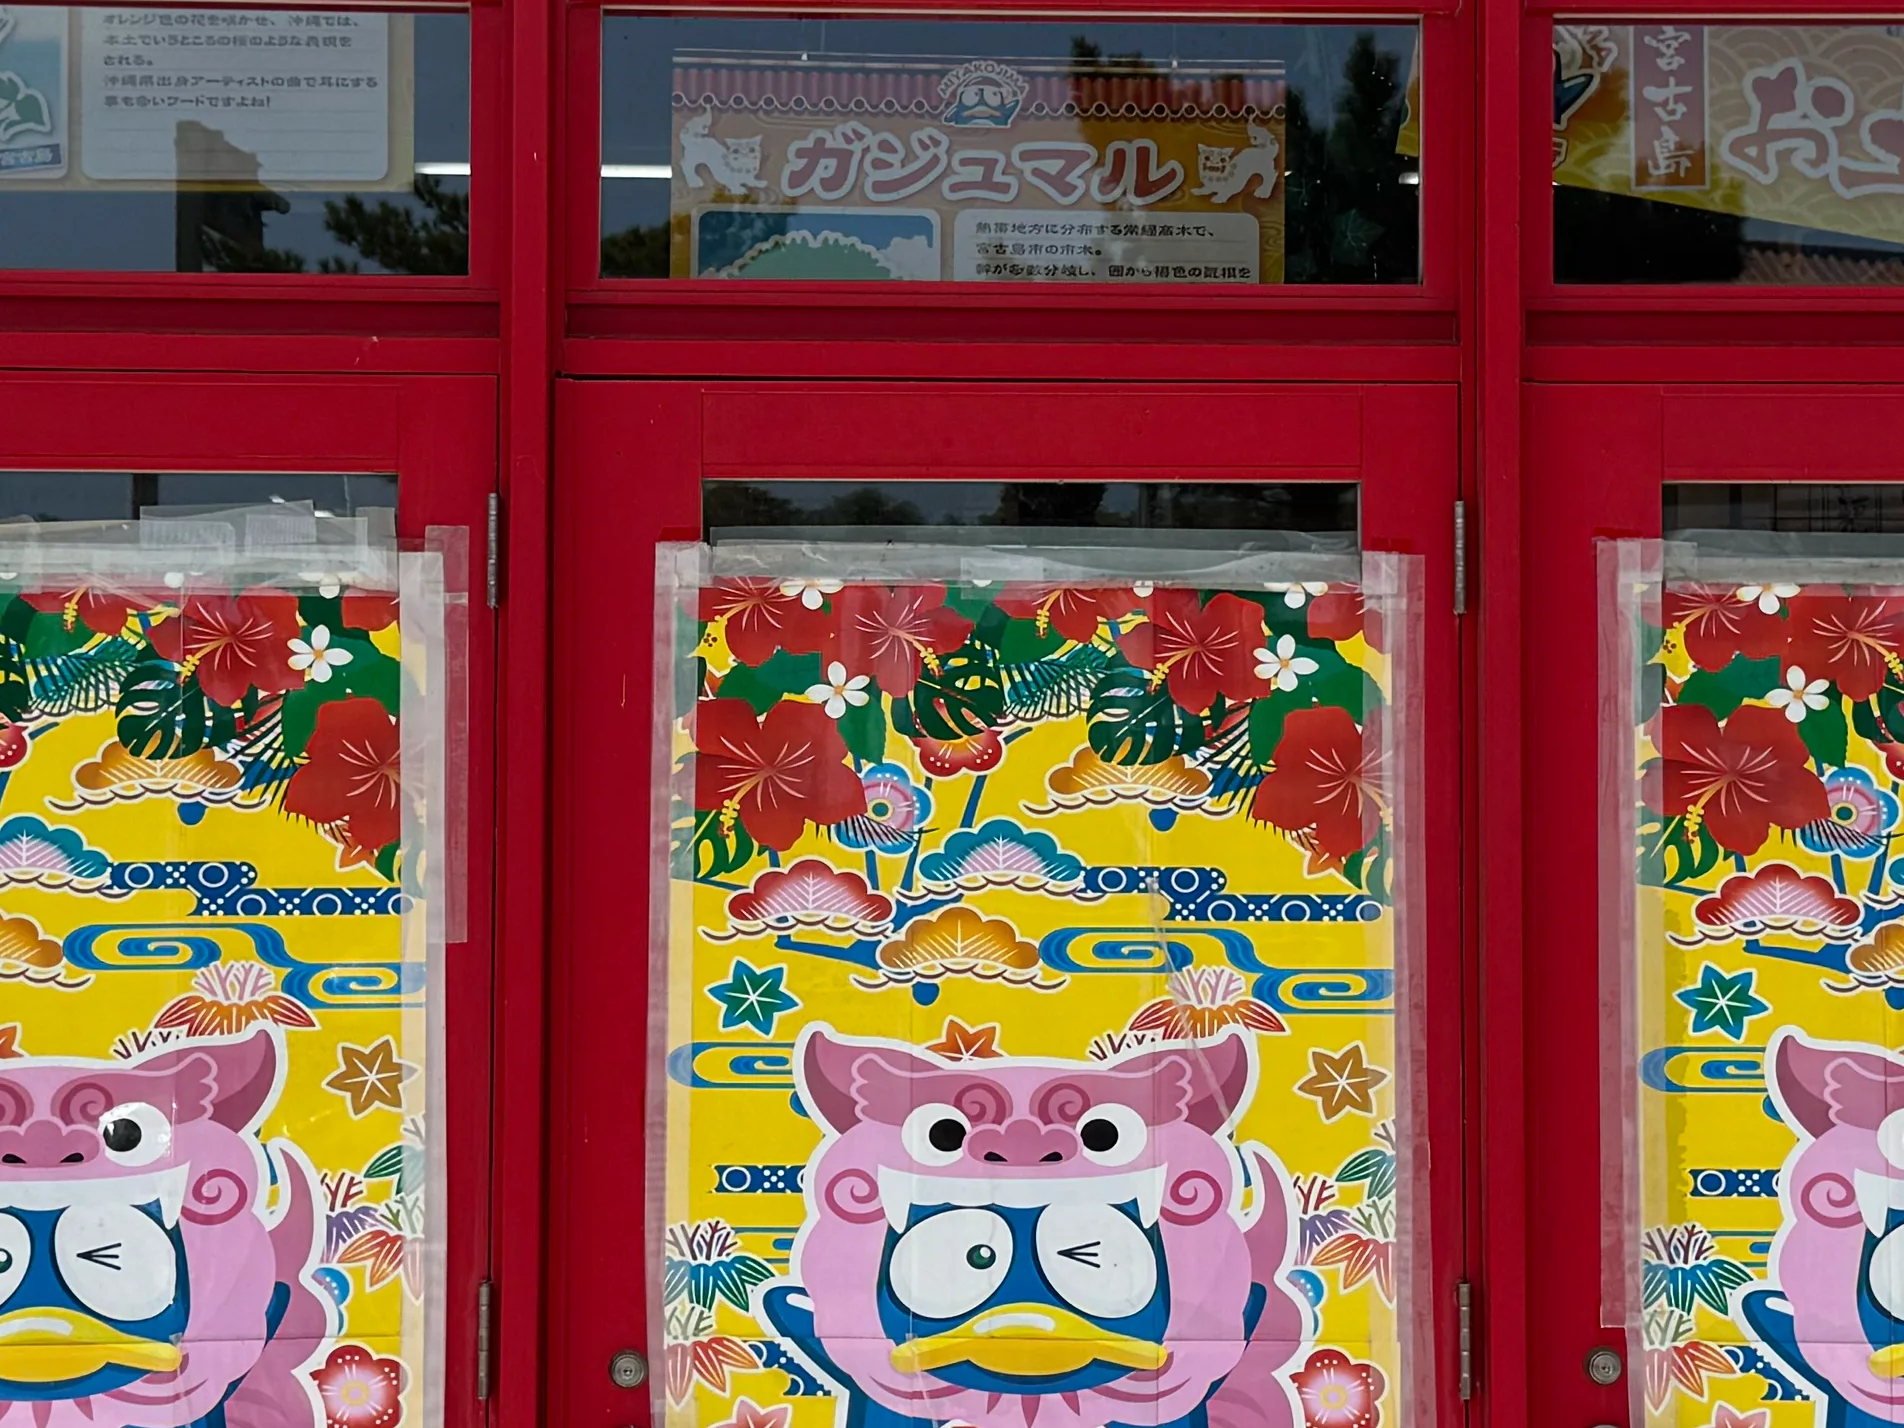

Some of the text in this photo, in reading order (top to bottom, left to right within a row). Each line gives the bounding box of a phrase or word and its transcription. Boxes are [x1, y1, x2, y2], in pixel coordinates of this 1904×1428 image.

[938, 61, 1029, 99] MIYAKOJIMA
[1642, 25, 1696, 178] 宮古島
[781, 123, 1184, 205] ガジュマル
